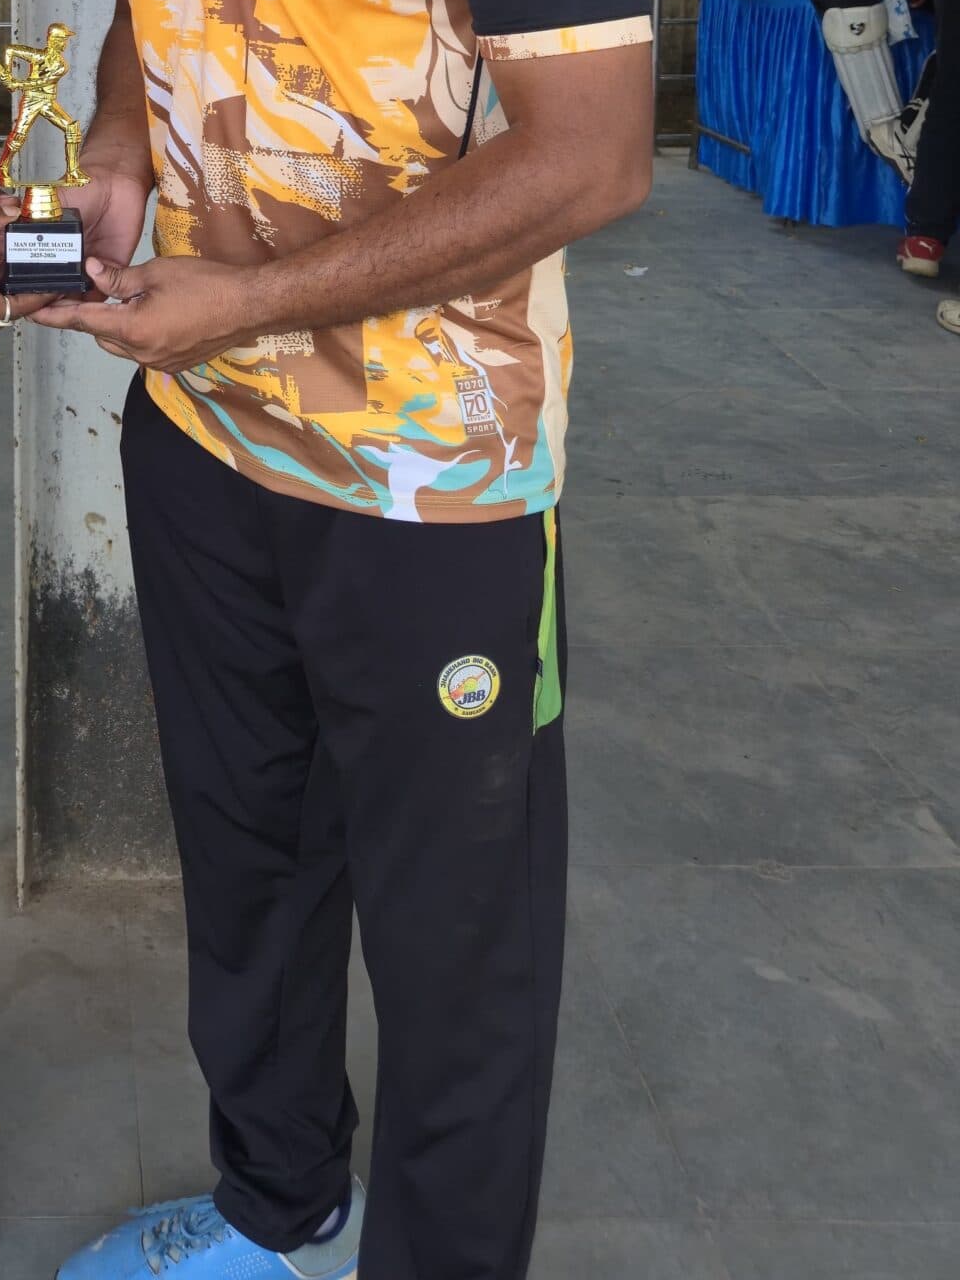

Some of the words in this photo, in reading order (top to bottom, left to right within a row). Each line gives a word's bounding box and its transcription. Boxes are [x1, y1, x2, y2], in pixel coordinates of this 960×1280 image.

[458, 380, 484, 390] 7070
[467, 423, 494, 433] SPORT
[458, 689, 486, 705] JBB
